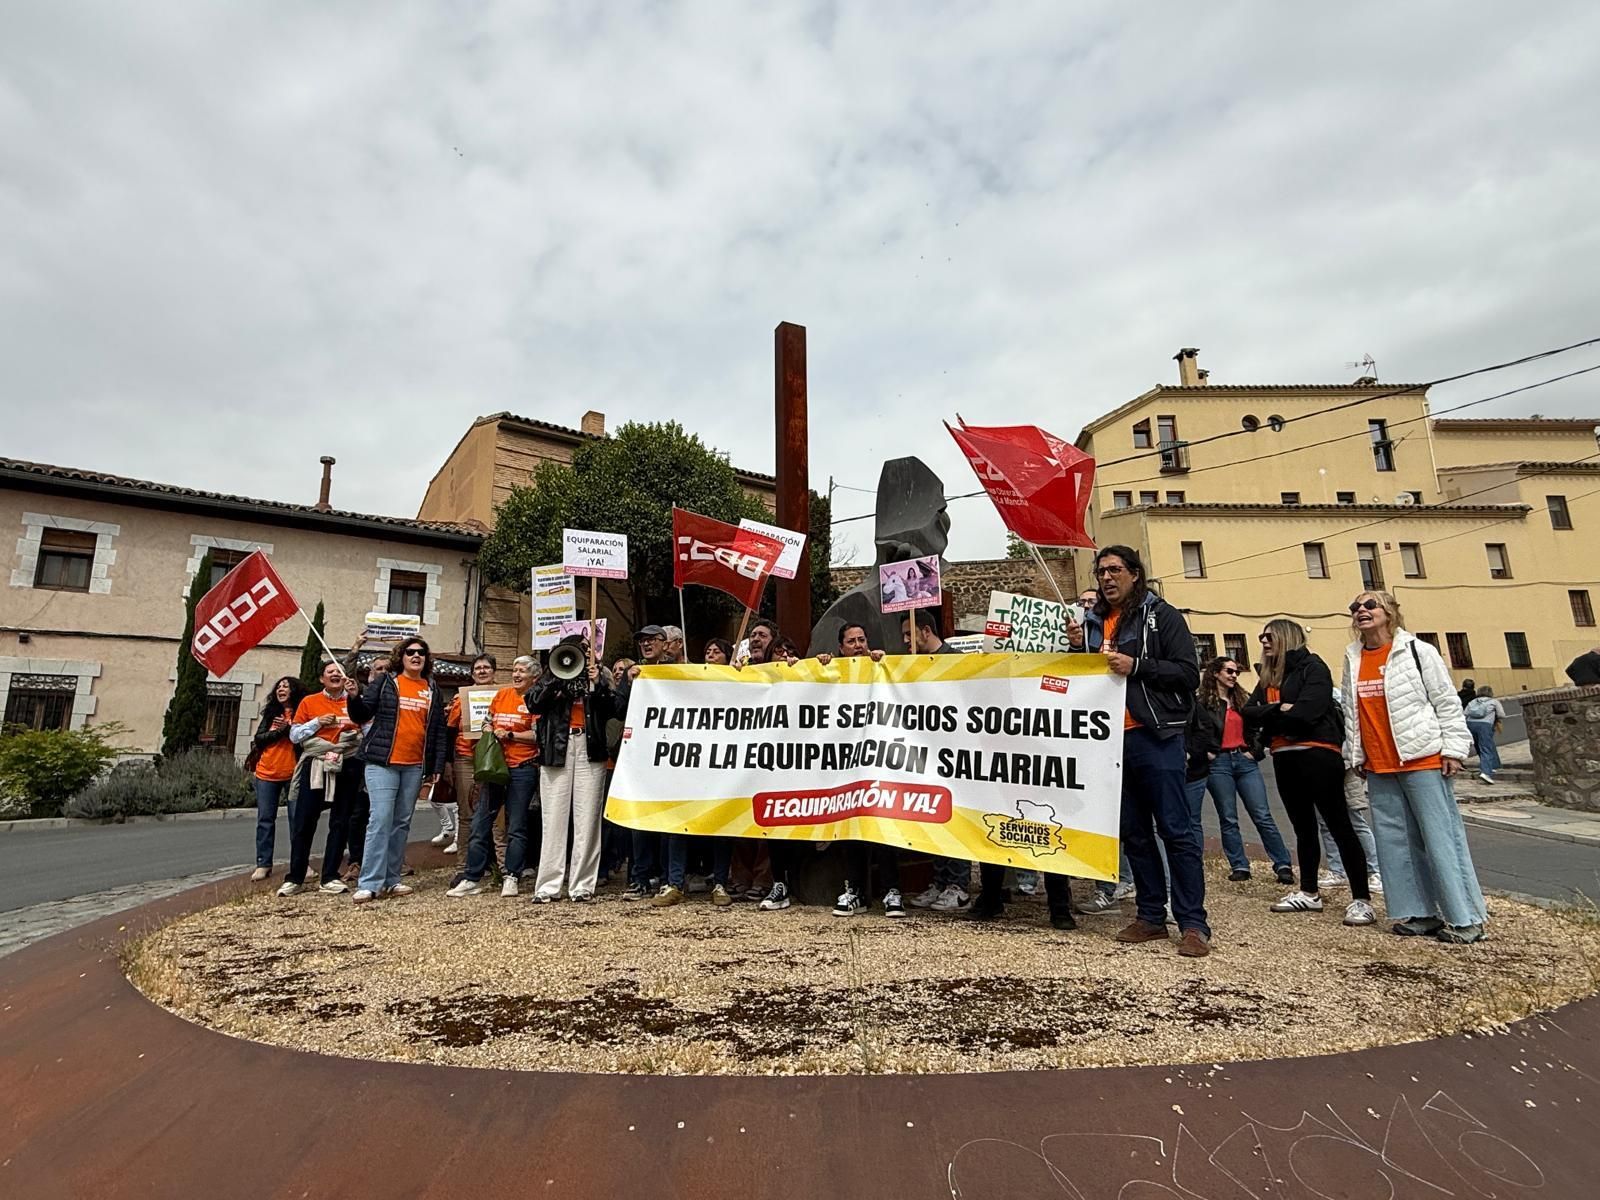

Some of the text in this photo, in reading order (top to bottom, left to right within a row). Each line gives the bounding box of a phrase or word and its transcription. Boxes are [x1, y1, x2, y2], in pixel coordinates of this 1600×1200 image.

[566, 535, 624, 548] EQUIPARACIÓN
[577, 546, 614, 556] SALARIAL
[587, 558, 605, 567] ¡YA!
[644, 701, 1111, 741] PLATAFORMA DE SERVICIOS SOCIALES
[653, 738, 1085, 791] POR LA EQUIPARACIÓN SALARIAL
[762, 780, 943, 819] ¡EQUIPARACIÓN YA!
[999, 822, 1051, 836] SERVICIOS
[999, 831, 1050, 845] SOCIALES
